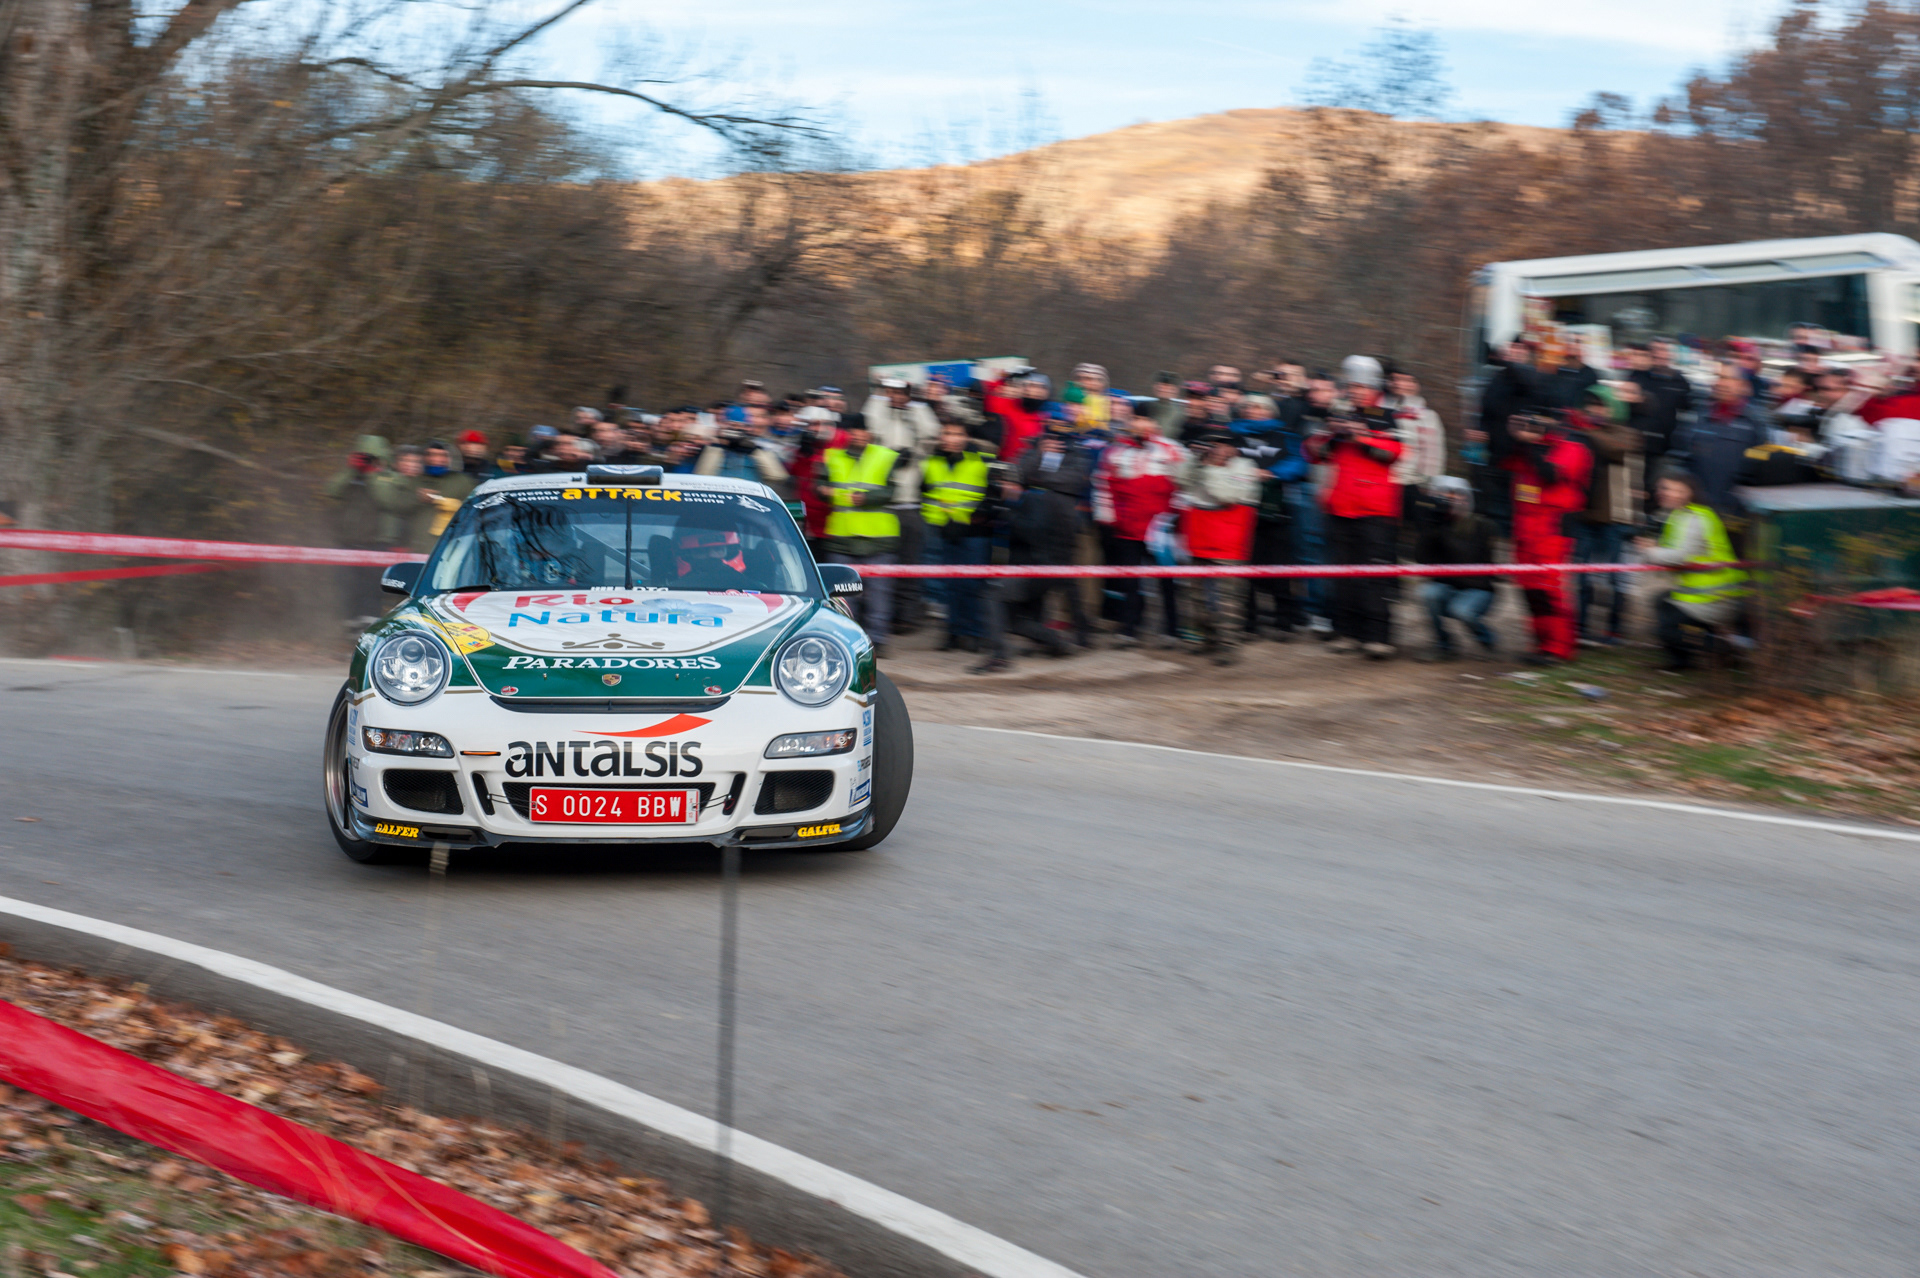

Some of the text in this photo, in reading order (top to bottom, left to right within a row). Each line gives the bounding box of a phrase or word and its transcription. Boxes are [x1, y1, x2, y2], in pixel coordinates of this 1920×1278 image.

[515, 594, 635, 608] Rio
[508, 610, 724, 628] Natura
[502, 656, 722, 670] PARADORES
[535, 795, 682, 818] S 0024 BBW
[375, 823, 420, 838] GALFER
[797, 823, 843, 838] GALFER
